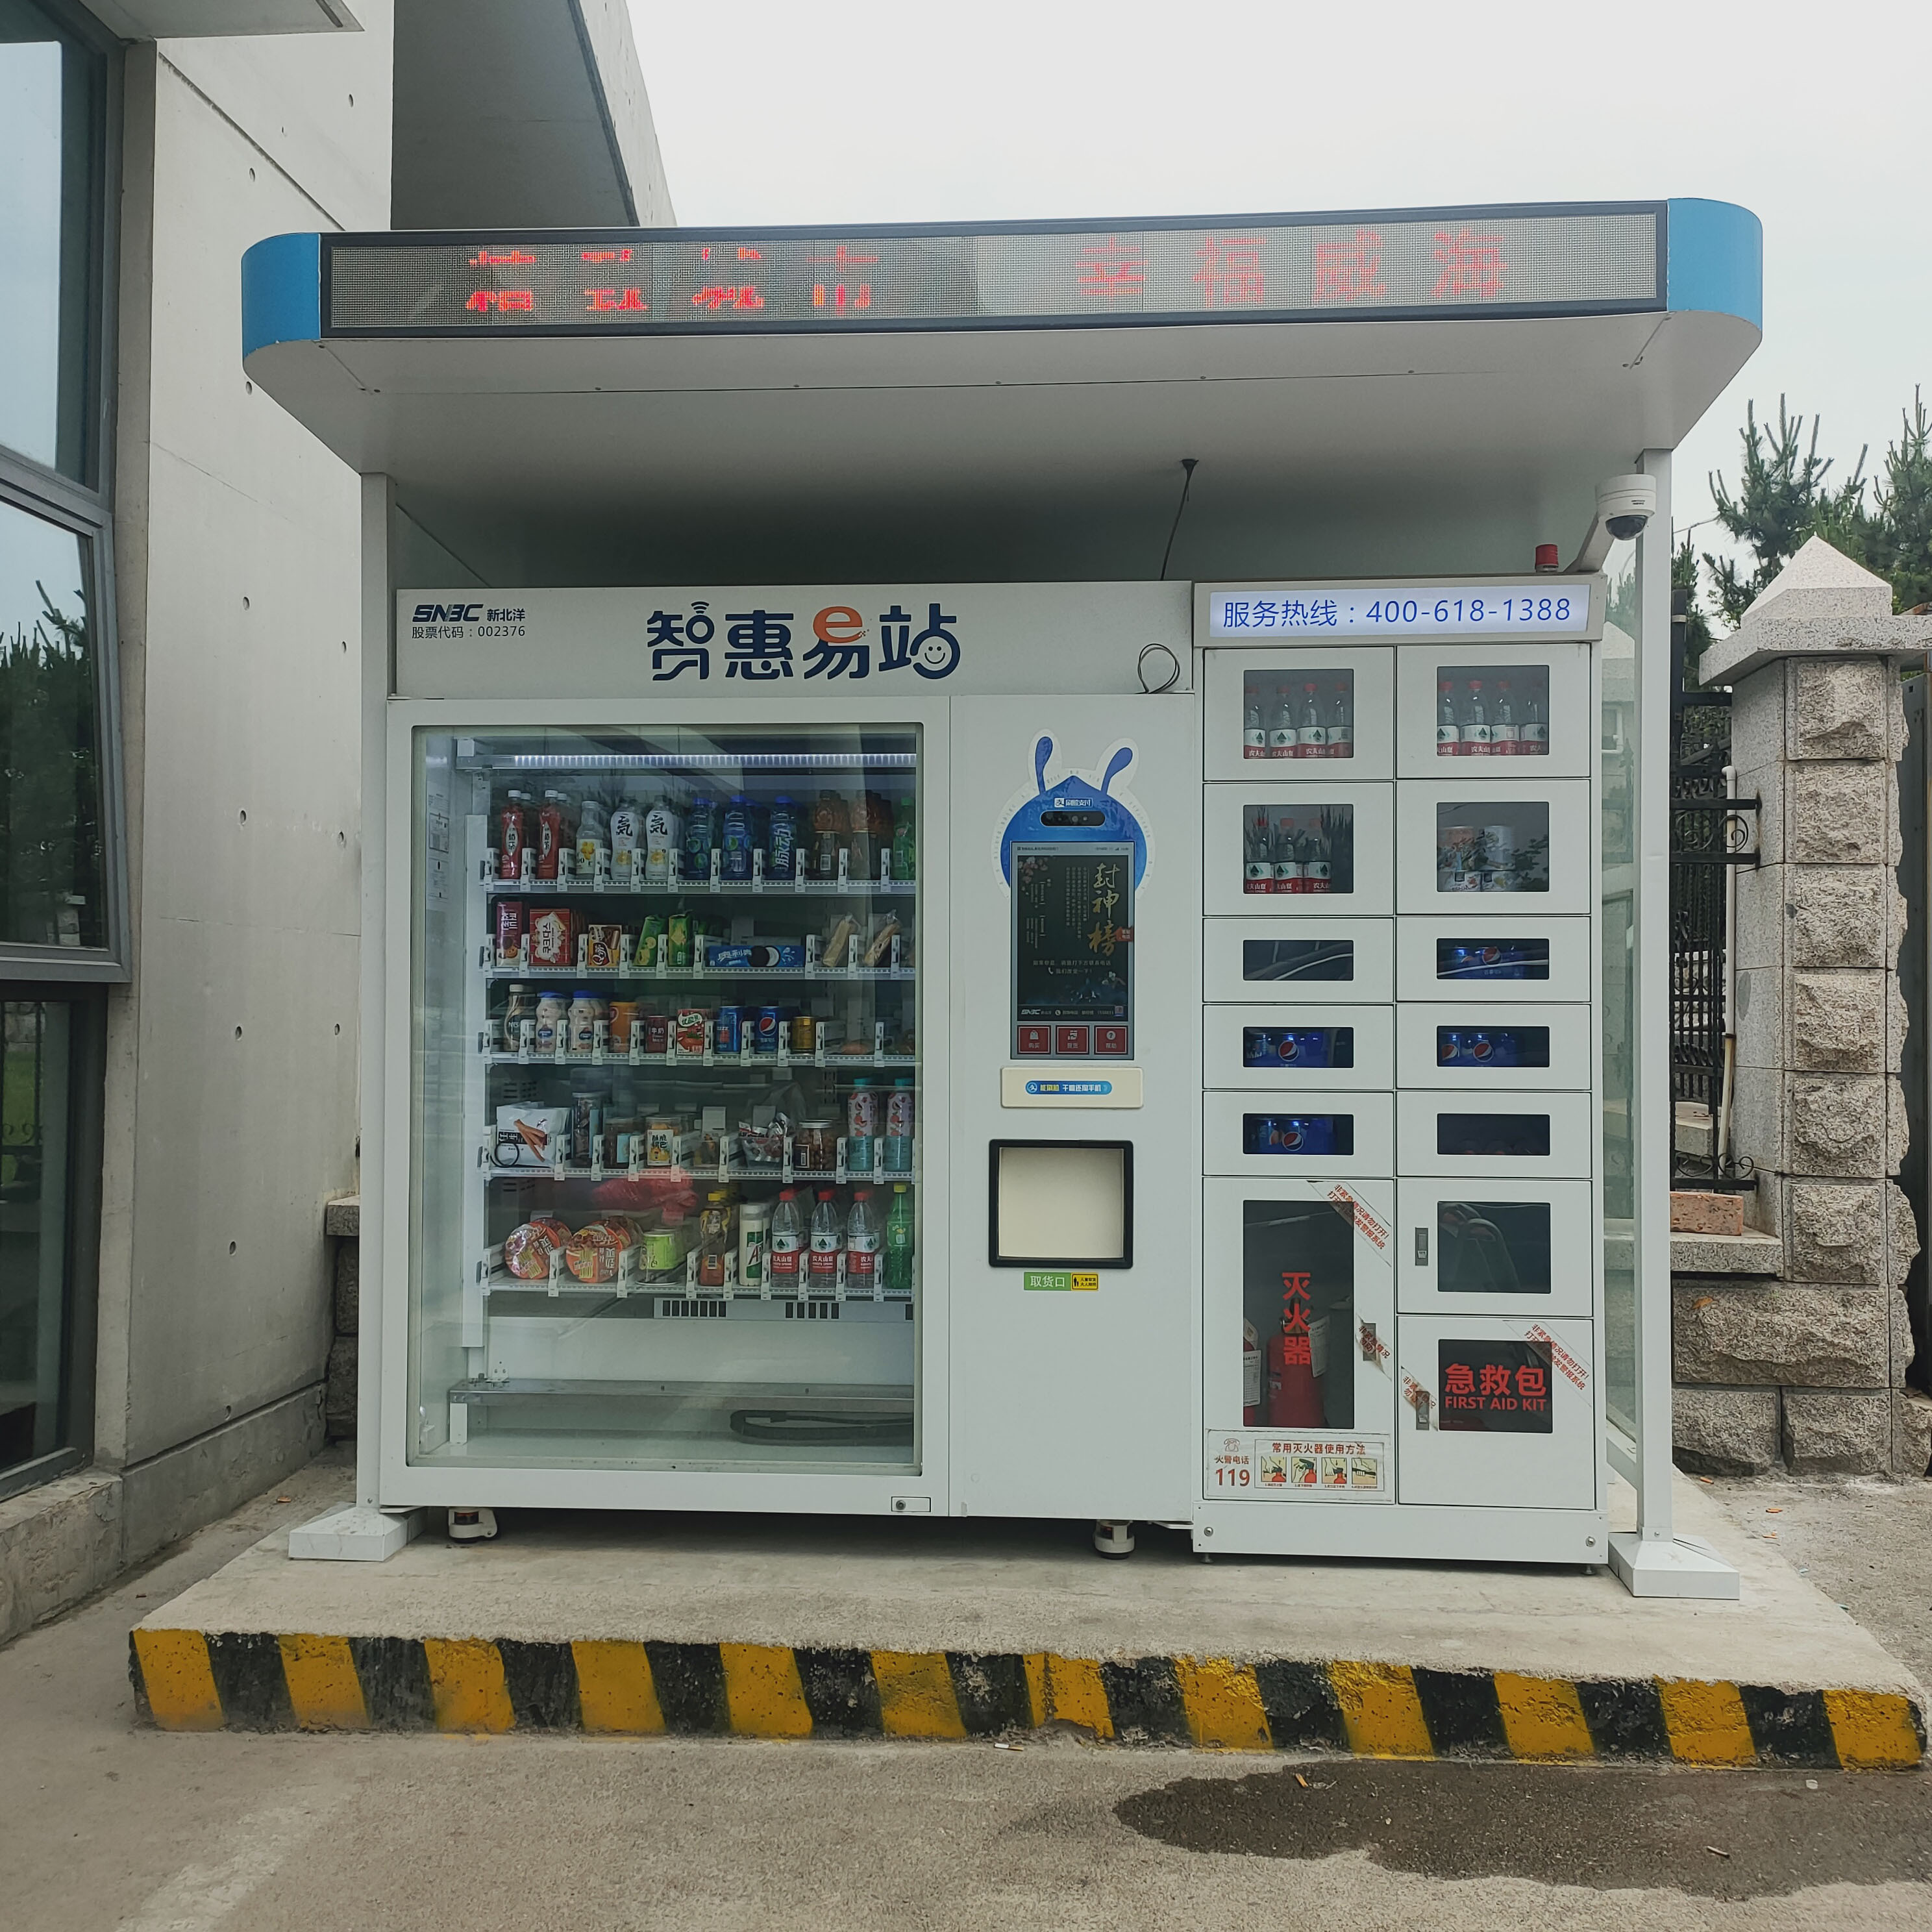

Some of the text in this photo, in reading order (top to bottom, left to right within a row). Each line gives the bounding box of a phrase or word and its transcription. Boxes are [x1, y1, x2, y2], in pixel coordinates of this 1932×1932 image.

[1076, 229, 1508, 309] 幸福威海
[412, 604, 526, 622] SNBC 新北洋
[1223, 599, 1571, 629] 服务热线：400-618-1388
[412, 626, 526, 639] 股票代码：002376
[1030, 1276, 1065, 1287] 取货口
[1282, 1272, 1311, 1365] 灭火器
[1445, 1363, 1546, 1396] 急救包
[1445, 1396, 1547, 1412] FIRST AID KIT
[1272, 1442, 1366, 1455] 常用灭火器使用方法
[1215, 1455, 1249, 1465] 火警电话
[1216, 1468, 1250, 1487] 119
